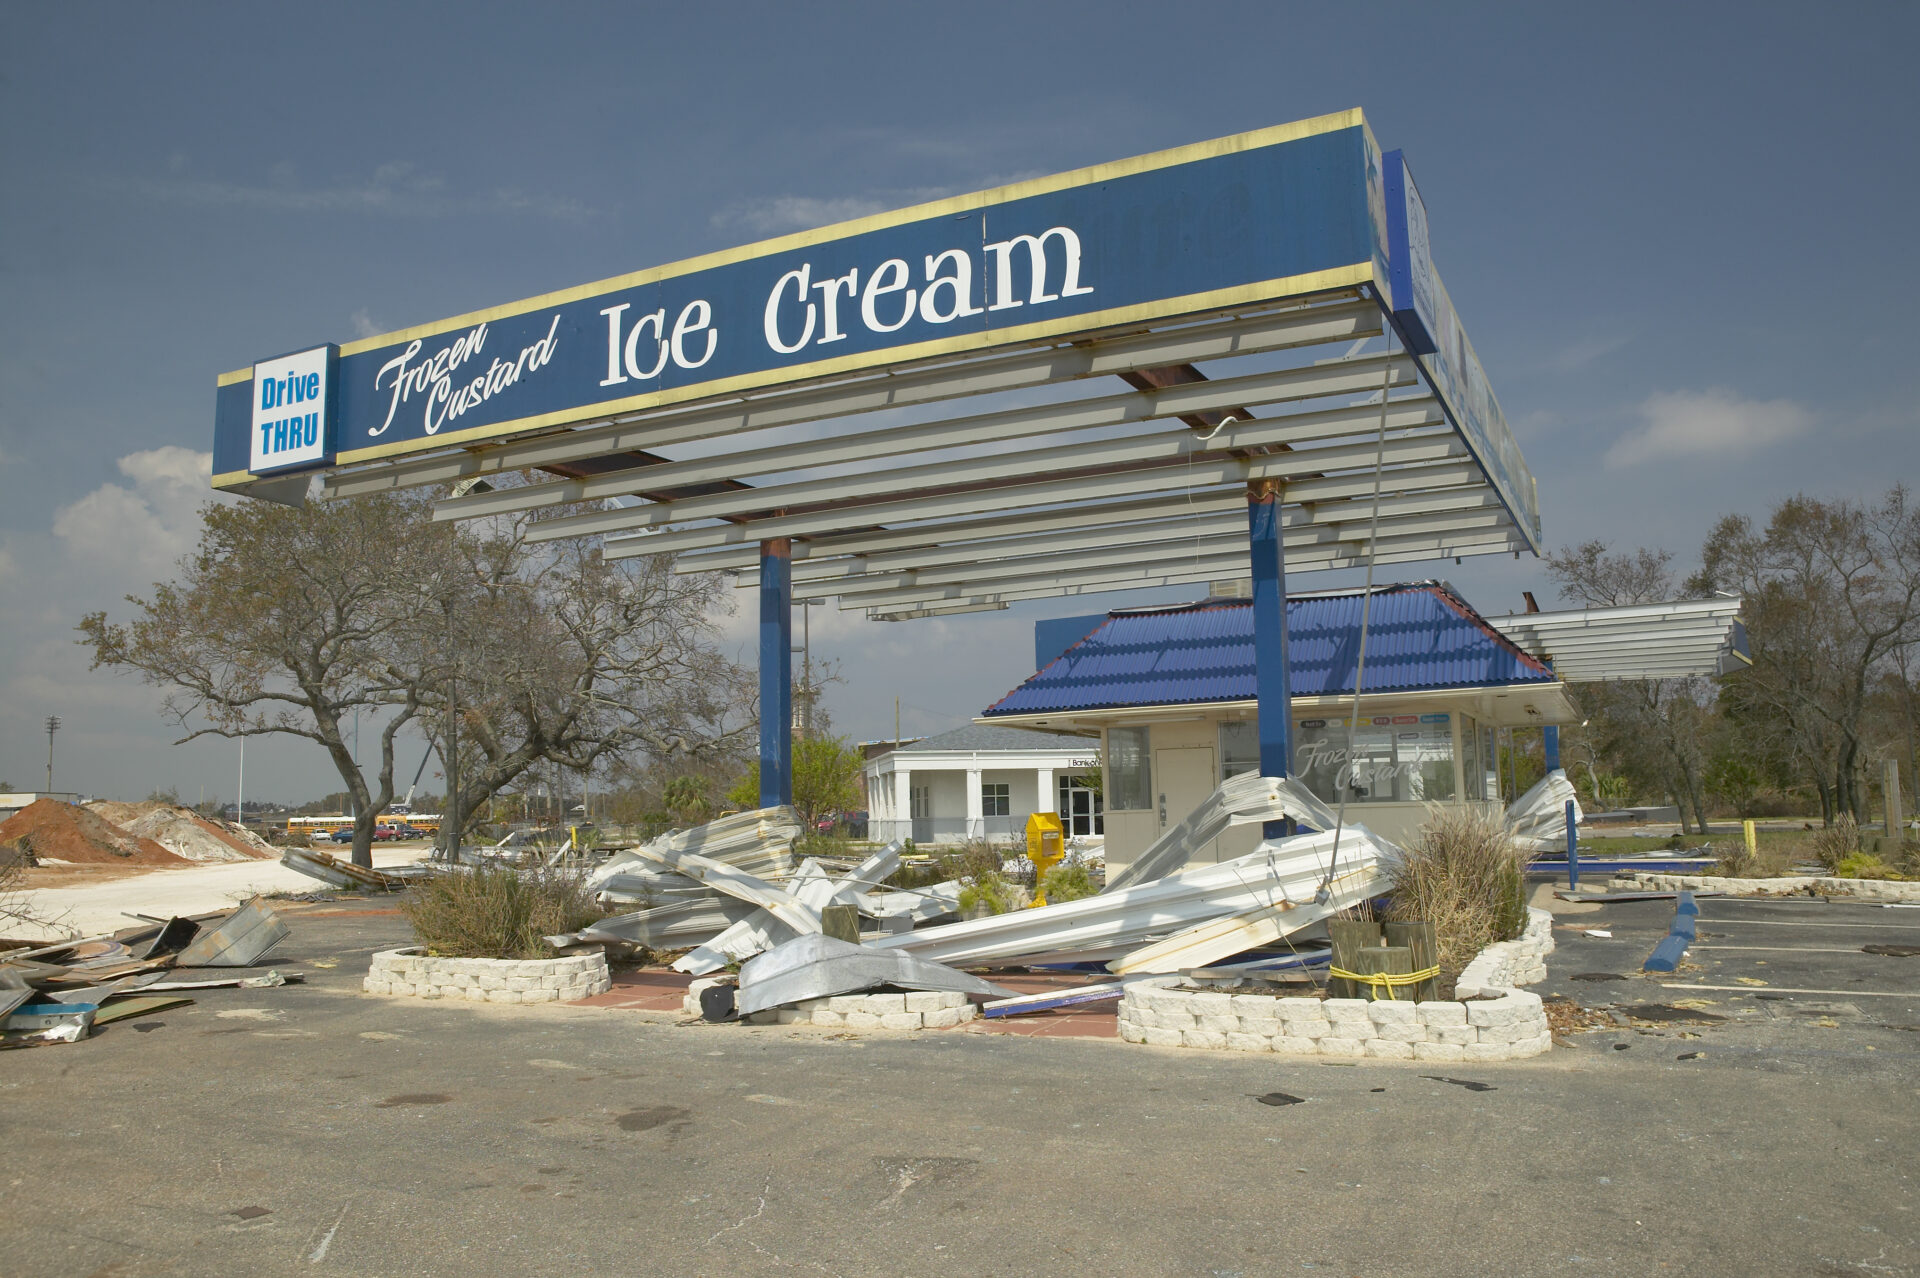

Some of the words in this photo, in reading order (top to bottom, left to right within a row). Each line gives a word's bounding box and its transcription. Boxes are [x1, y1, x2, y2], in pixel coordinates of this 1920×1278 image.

[600, 299, 717, 387] Ice
[763, 226, 1094, 354] Cream
[261, 370, 320, 411] Drive
[368, 322, 489, 437] Frozen
[424, 314, 561, 435] Custard
[261, 412, 319, 456] THRU
[1072, 759, 1089, 767] Bank
[1295, 738, 1369, 779] Frozen
[1335, 751, 1423, 791] Custard
